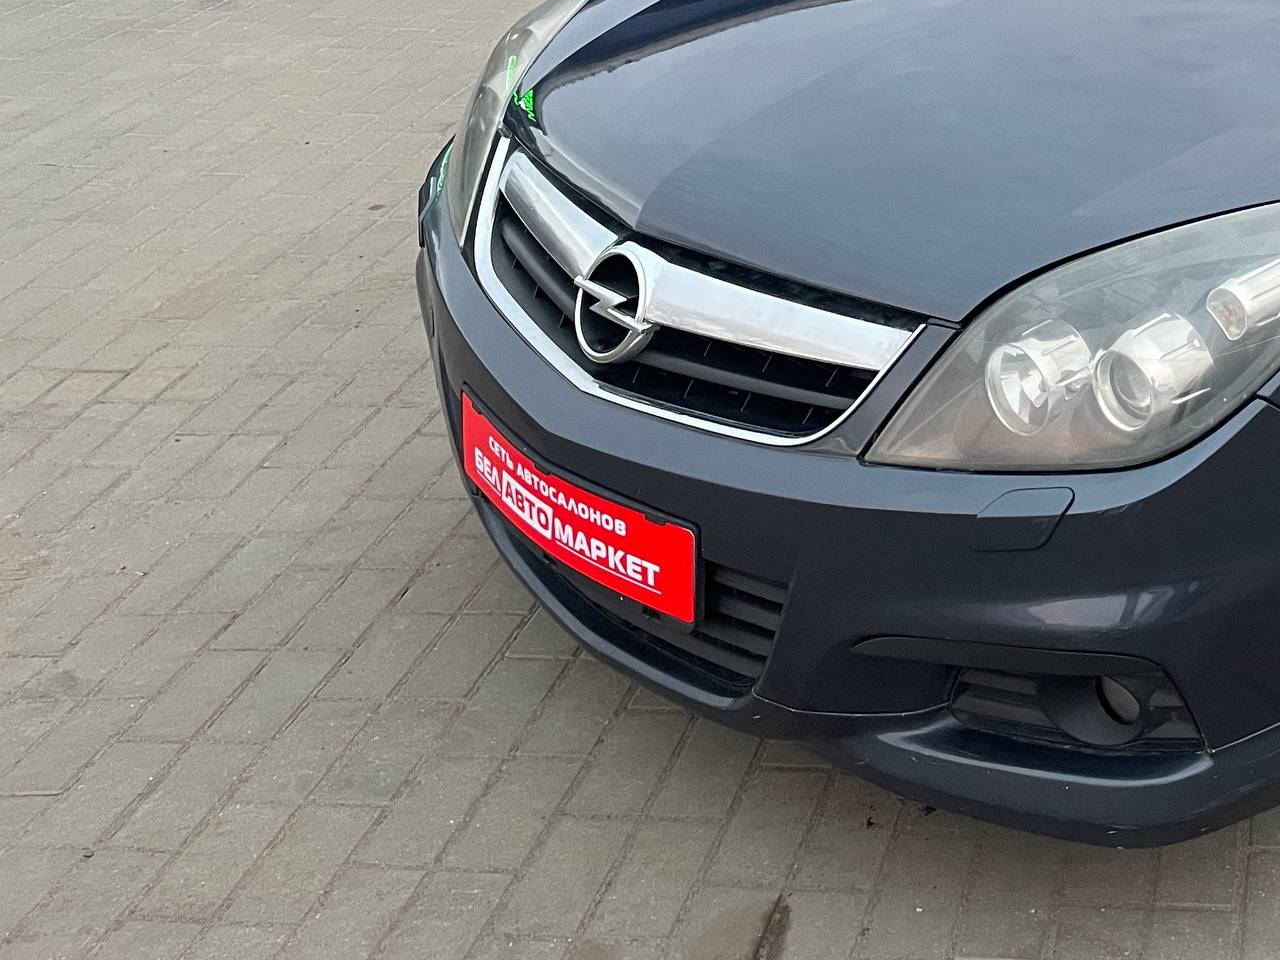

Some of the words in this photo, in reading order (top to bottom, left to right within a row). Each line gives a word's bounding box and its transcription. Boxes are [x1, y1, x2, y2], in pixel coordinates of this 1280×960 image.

[474, 446, 501, 491] БЕЛ
[505, 482, 550, 533] АВТО
[554, 517, 661, 587] МАРКЕТ
[488, 436, 514, 470] СЕТЬ
[516, 465, 627, 537] АВТОСАЛОНОВ
